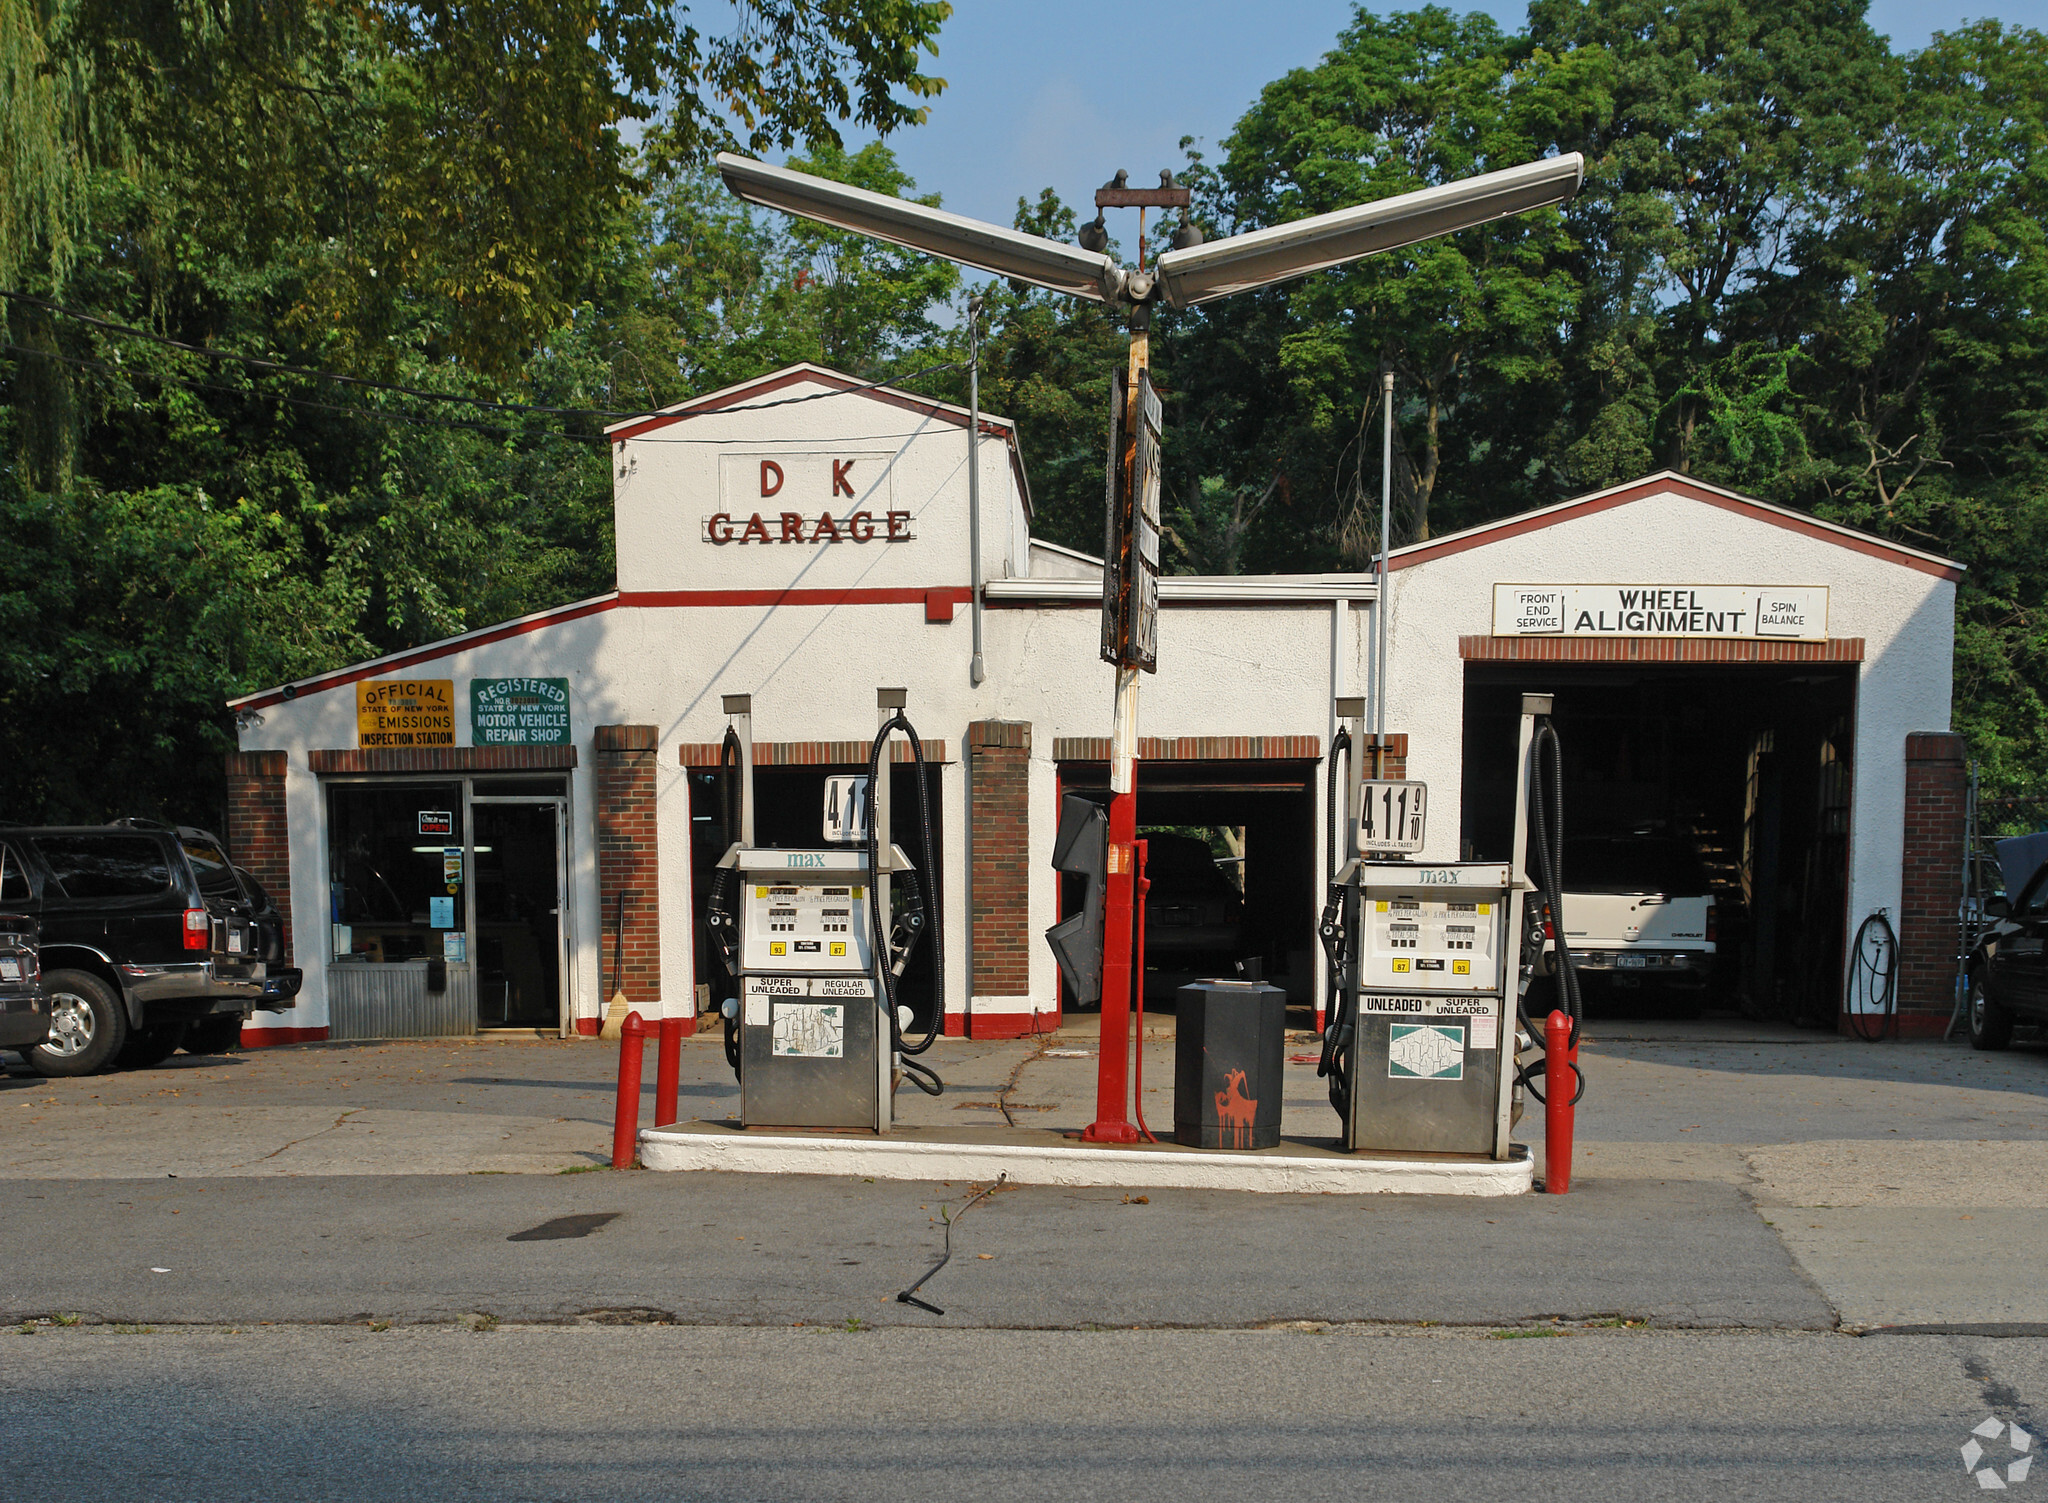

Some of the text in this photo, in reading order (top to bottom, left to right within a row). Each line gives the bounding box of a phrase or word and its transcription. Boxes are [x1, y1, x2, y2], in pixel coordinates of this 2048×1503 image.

[761, 459, 856, 498] D K
[708, 511, 911, 542] GARAGE
[1520, 594, 1556, 604] FRONT
[1619, 590, 1703, 610] WHEEL
[1526, 605, 1550, 616] END
[1771, 602, 1797, 613] SPIN
[1516, 617, 1558, 628] SERVICE
[1574, 610, 1747, 632] ALIGNMENT
[1761, 614, 1805, 625] BALANCE
[366, 683, 446, 704] OFFICIAL
[477, 679, 565, 703] REGISTERED
[378, 716, 451, 728] EMISSIONS
[477, 714, 567, 727] MOTOR VEHICLE
[361, 731, 453, 745] INSPECTION STATION
[486, 729, 561, 742] REPAIR SHOP
[1362, 786, 1407, 840] 4.11
[422, 824, 449, 832] OPEN
[787, 853, 826, 868] max
[1418, 869, 1461, 884] max
[760, 978, 792, 987] SUPER
[825, 980, 863, 988] REGULAR
[751, 986, 800, 995] UNLEADED
[822, 988, 866, 996] UNLEADED
[1367, 998, 1422, 1012] UNLEADED
[1446, 998, 1480, 1006] SUPER
[1436, 1006, 1489, 1014] UNLEADED
